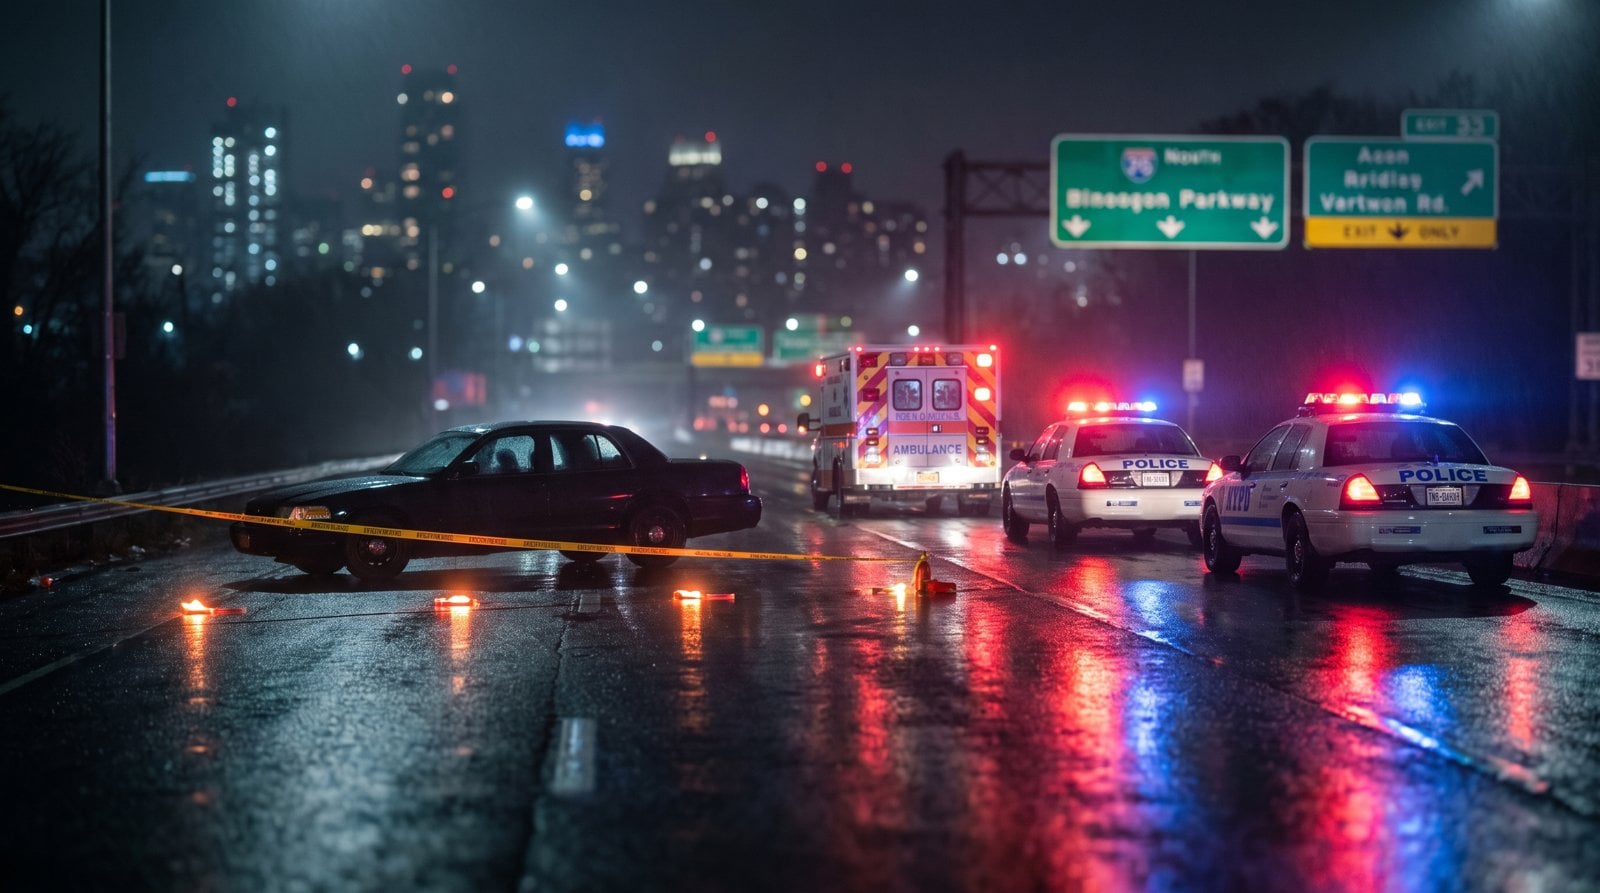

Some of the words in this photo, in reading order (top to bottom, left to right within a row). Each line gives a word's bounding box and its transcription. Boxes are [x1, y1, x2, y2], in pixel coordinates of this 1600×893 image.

[1179, 188, 1274, 214] Parkway
[1343, 225, 1377, 240] EXIT
[1418, 225, 1460, 240] ONLY
[893, 444, 962, 455] AMBULANCE
[1122, 459, 1190, 470] POLICE
[1398, 468, 1488, 483] POLICE
[1226, 486, 1250, 512] NYPD
